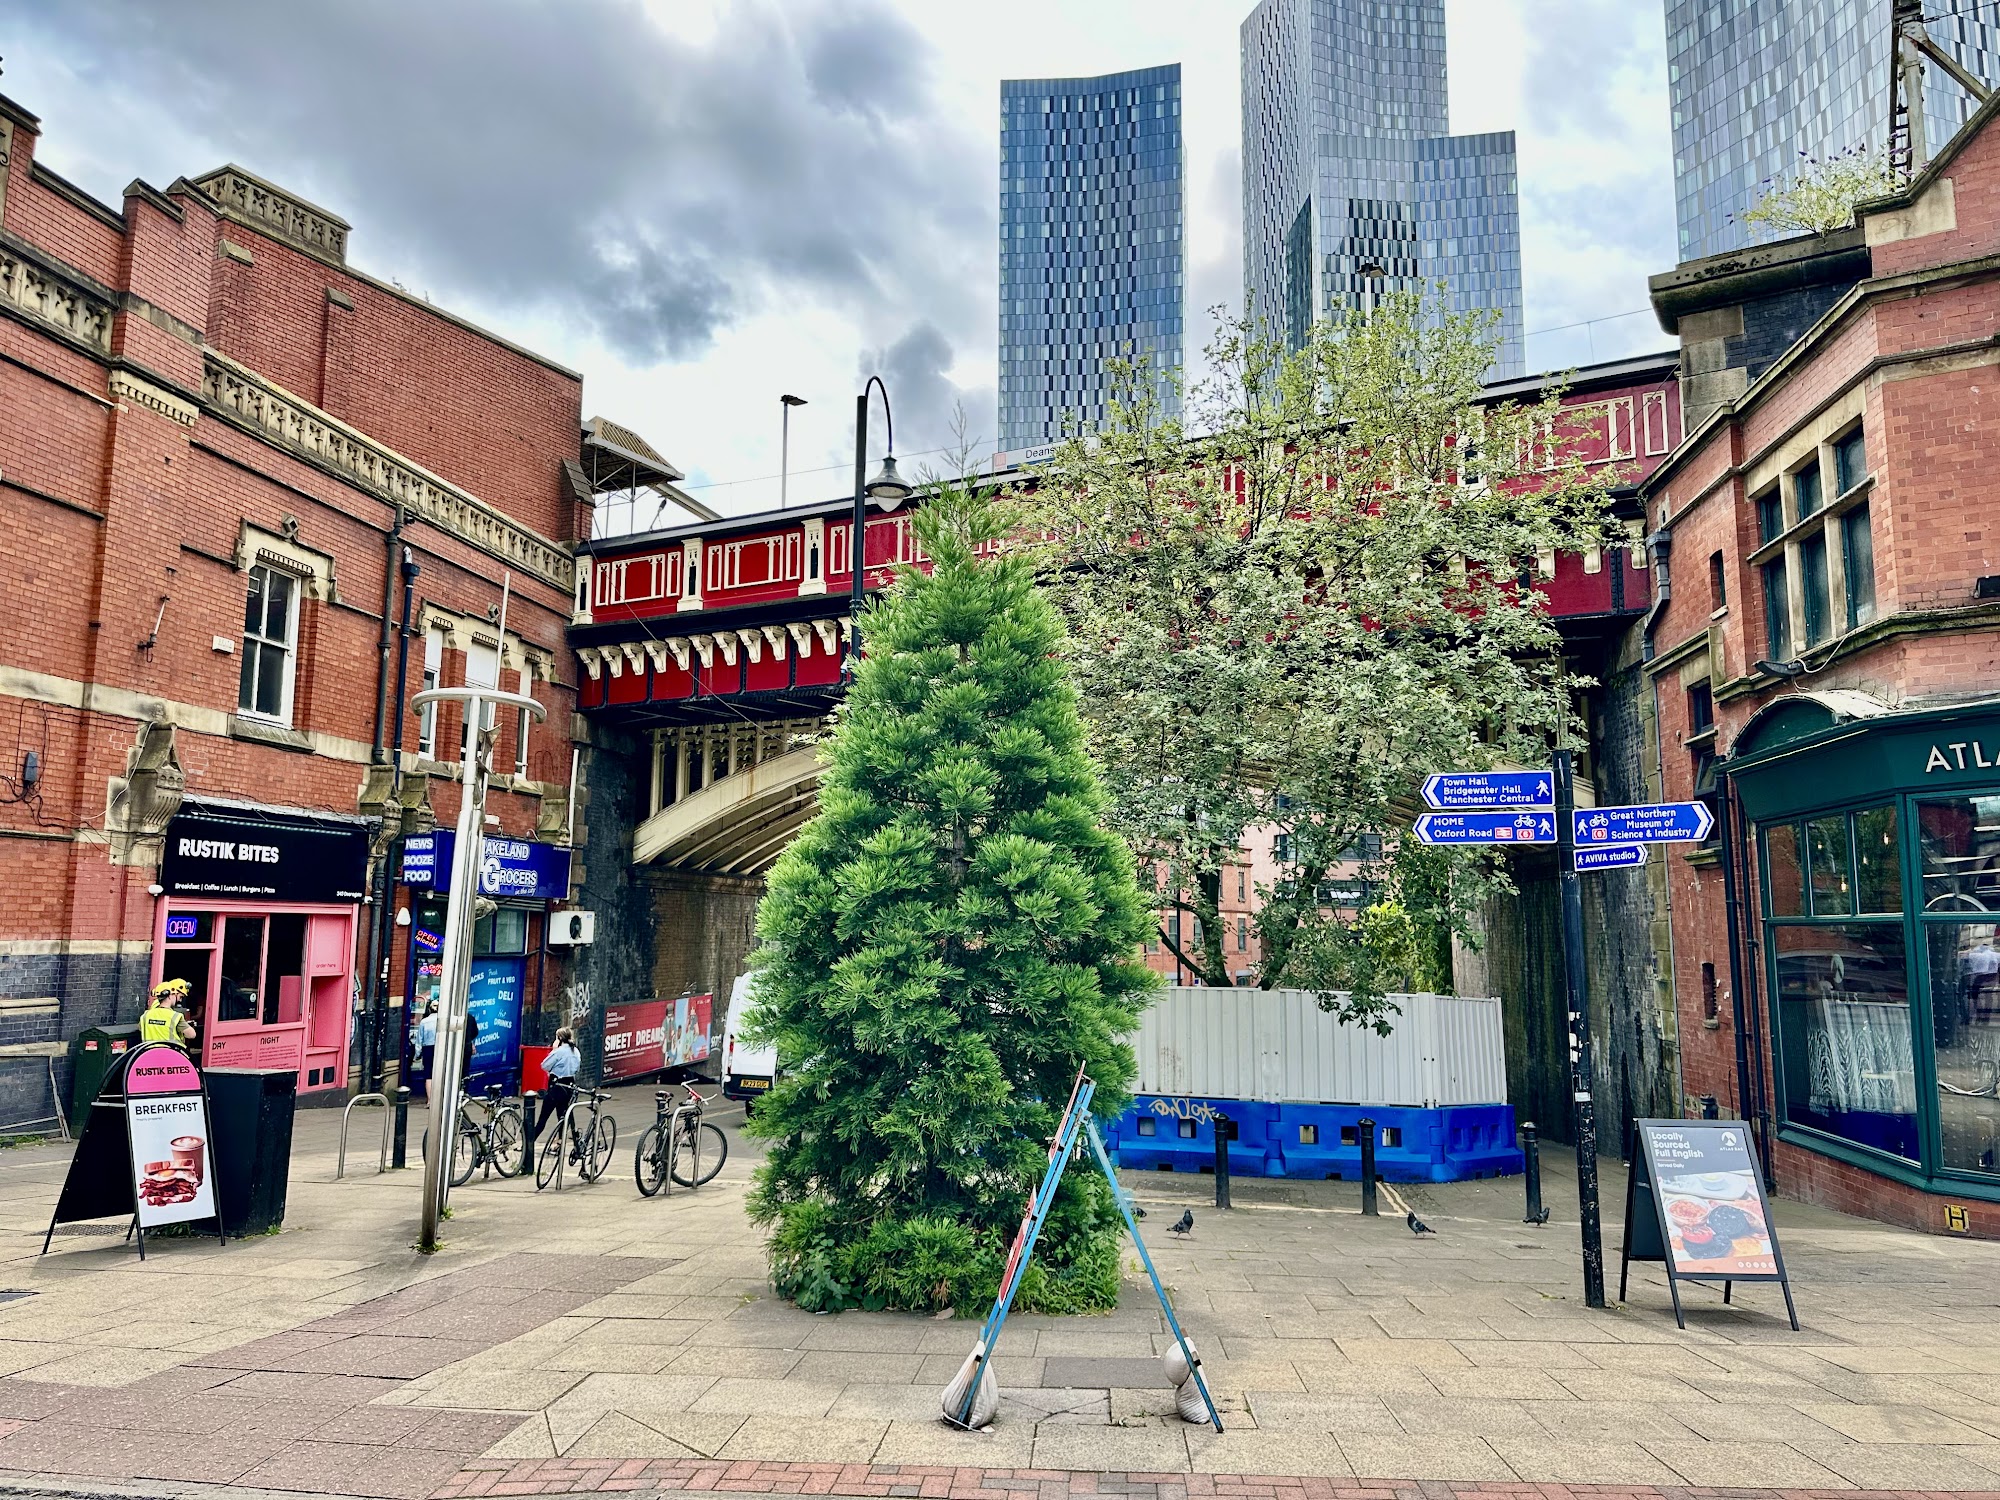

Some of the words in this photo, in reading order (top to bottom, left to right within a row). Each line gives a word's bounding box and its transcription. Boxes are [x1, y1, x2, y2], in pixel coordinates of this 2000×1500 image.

[1025, 446, 1060, 459] Deans
[1925, 741, 2000, 773] ATL
[1442, 778, 1466, 787] Town
[1468, 777, 1488, 786] Hall
[1443, 786, 1498, 796] Bridgewater
[1501, 785, 1521, 794] Hall
[1443, 795, 1496, 804] Manchester
[1499, 794, 1535, 803] Central
[1610, 811, 1634, 820] Great
[1636, 809, 1677, 819] Northern
[1433, 817, 1465, 826] HOME
[1626, 819, 1662, 829] Museum
[1664, 818, 1674, 827] of
[1434, 829, 1465, 838] Oxford
[1468, 828, 1492, 837] Road
[1611, 829, 1644, 840] Science
[1645, 829, 1653, 838] &
[1655, 827, 1691, 838] Industry
[405, 837, 434, 850] NEWS
[179, 838, 236, 860] RUSTIK
[238, 843, 280, 863] BITES
[403, 854, 434, 866] BOOZE
[1585, 853, 1609, 864] AVIVA
[1609, 851, 1636, 861] studios
[404, 870, 432, 882] FOOD
[482, 857, 538, 894] GROCERS
[174, 882, 200, 890] Breakfast
[242, 885, 261, 893] Burgers
[170, 920, 195, 934] OPEN
[417, 930, 438, 943] OPEN
[470, 972, 485, 985] ACKS
[487, 977, 501, 985] FRUIT
[506, 976, 516, 984] VEG
[498, 990, 514, 1001] DELI
[467, 998, 496, 1008] NDWICHES
[494, 1018, 512, 1029] DRINKS
[260, 1036, 280, 1045] NIGHT
[474, 1031, 500, 1047] ALCOHOL
[604, 1031, 632, 1052] SWEET
[635, 1026, 665, 1047] DREAMS
[211, 1041, 226, 1051] DAY
[135, 1066, 166, 1077] RUSTIK
[167, 1066, 190, 1074] BITES
[135, 1102, 198, 1115] BREAKFAST
[1651, 1132, 1684, 1141] Locally
[1653, 1141, 1690, 1149] Sourced
[1655, 1149, 1671, 1157] Full
[1673, 1150, 1704, 1159] English
